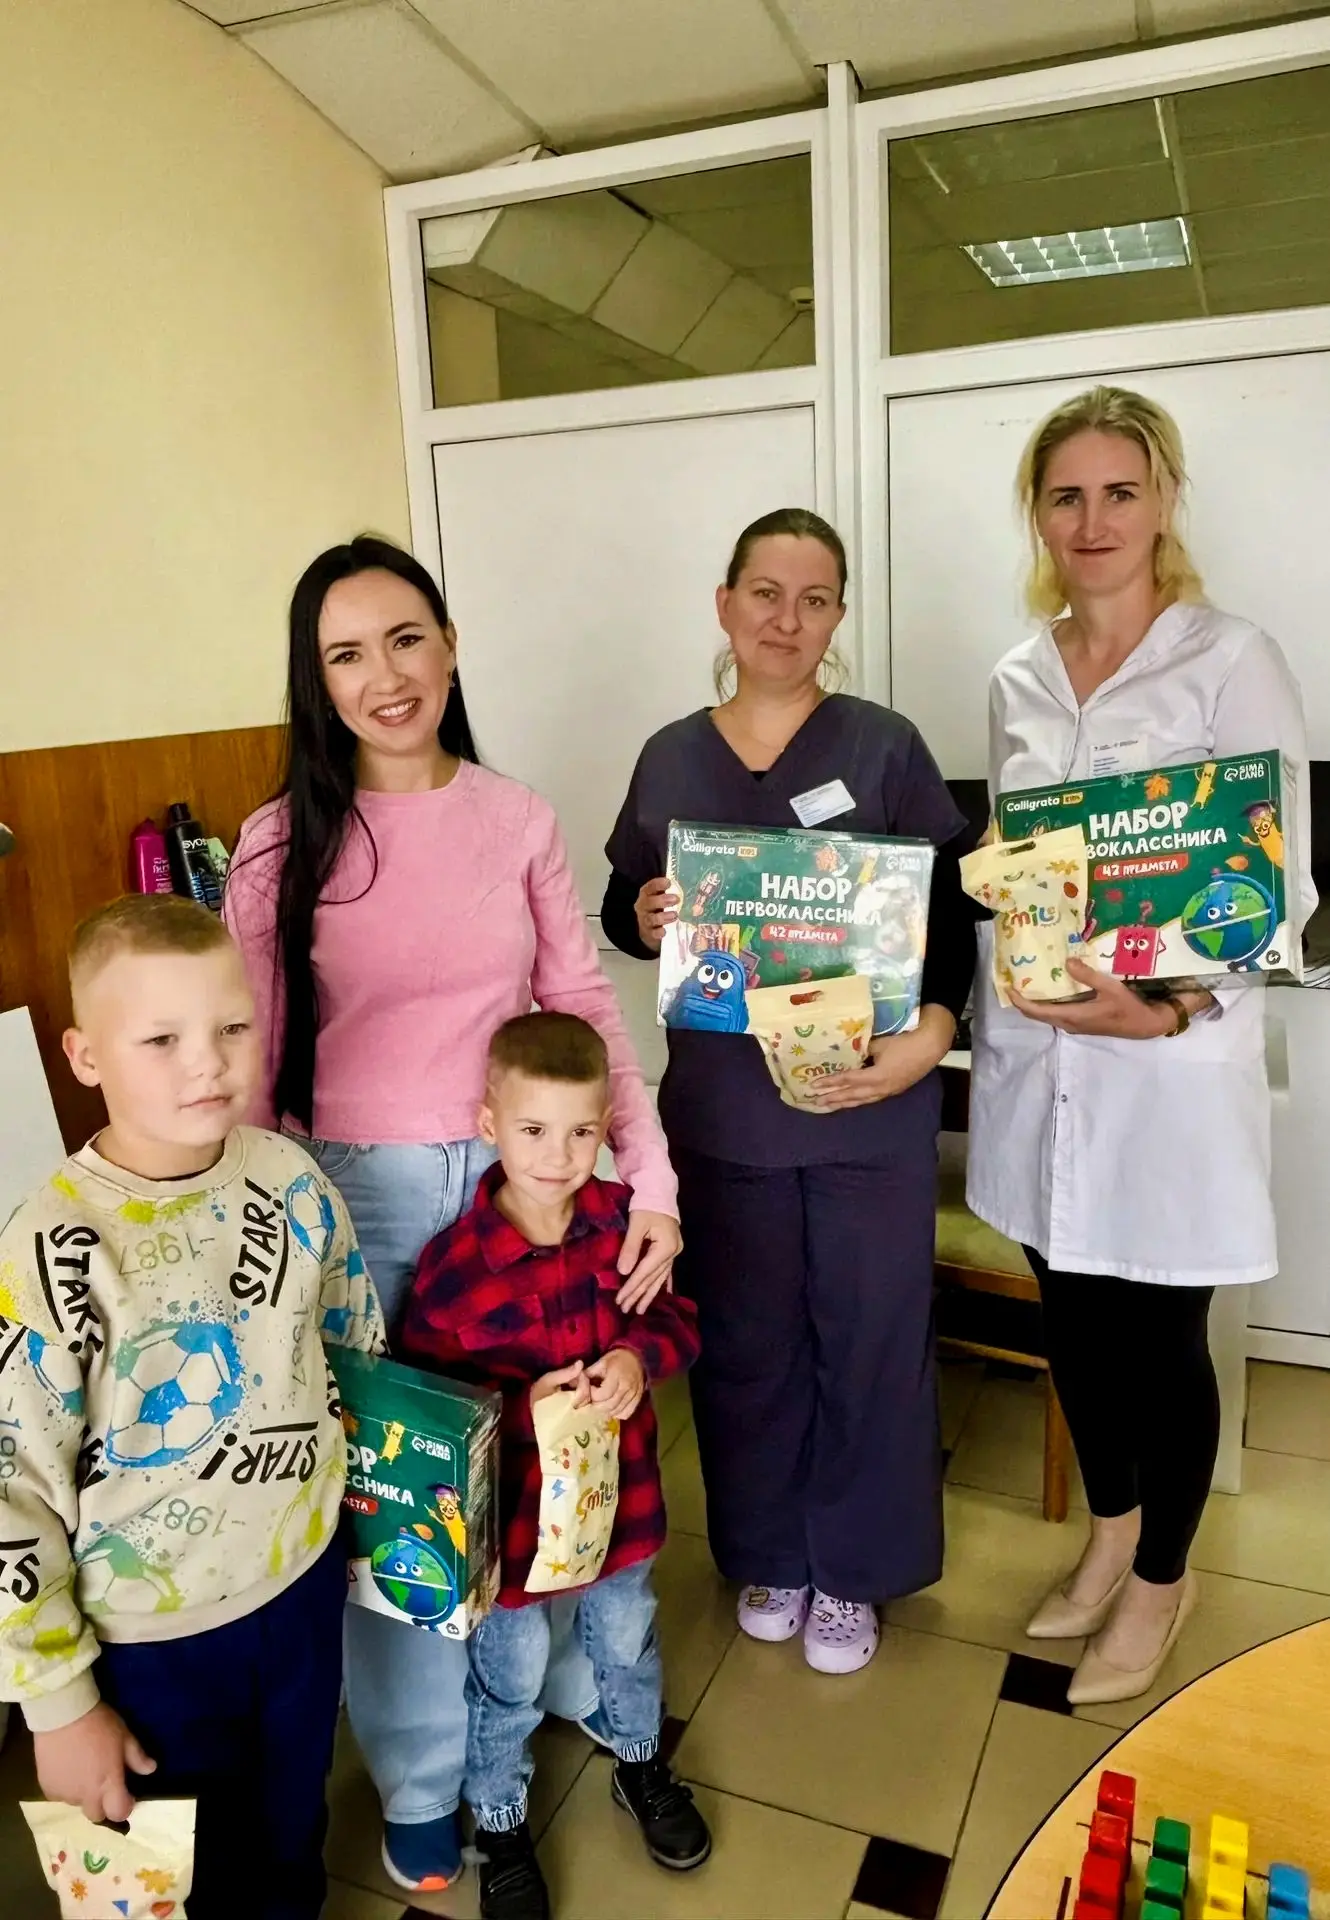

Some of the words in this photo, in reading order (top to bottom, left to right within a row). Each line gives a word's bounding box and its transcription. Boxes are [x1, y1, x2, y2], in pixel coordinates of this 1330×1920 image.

[1088, 801, 1189, 840] НАБОР
[1102, 865, 1120, 877] 42
[1123, 860, 1179, 875] ПРЕДМЕТА
[761, 872, 852, 903] НАБОР
[769, 926, 786, 939] 42
[229, 1177, 284, 1306] STAR!
[197, 1433, 318, 1485] STAR!
[346, 1474, 414, 1507] СНИКА
